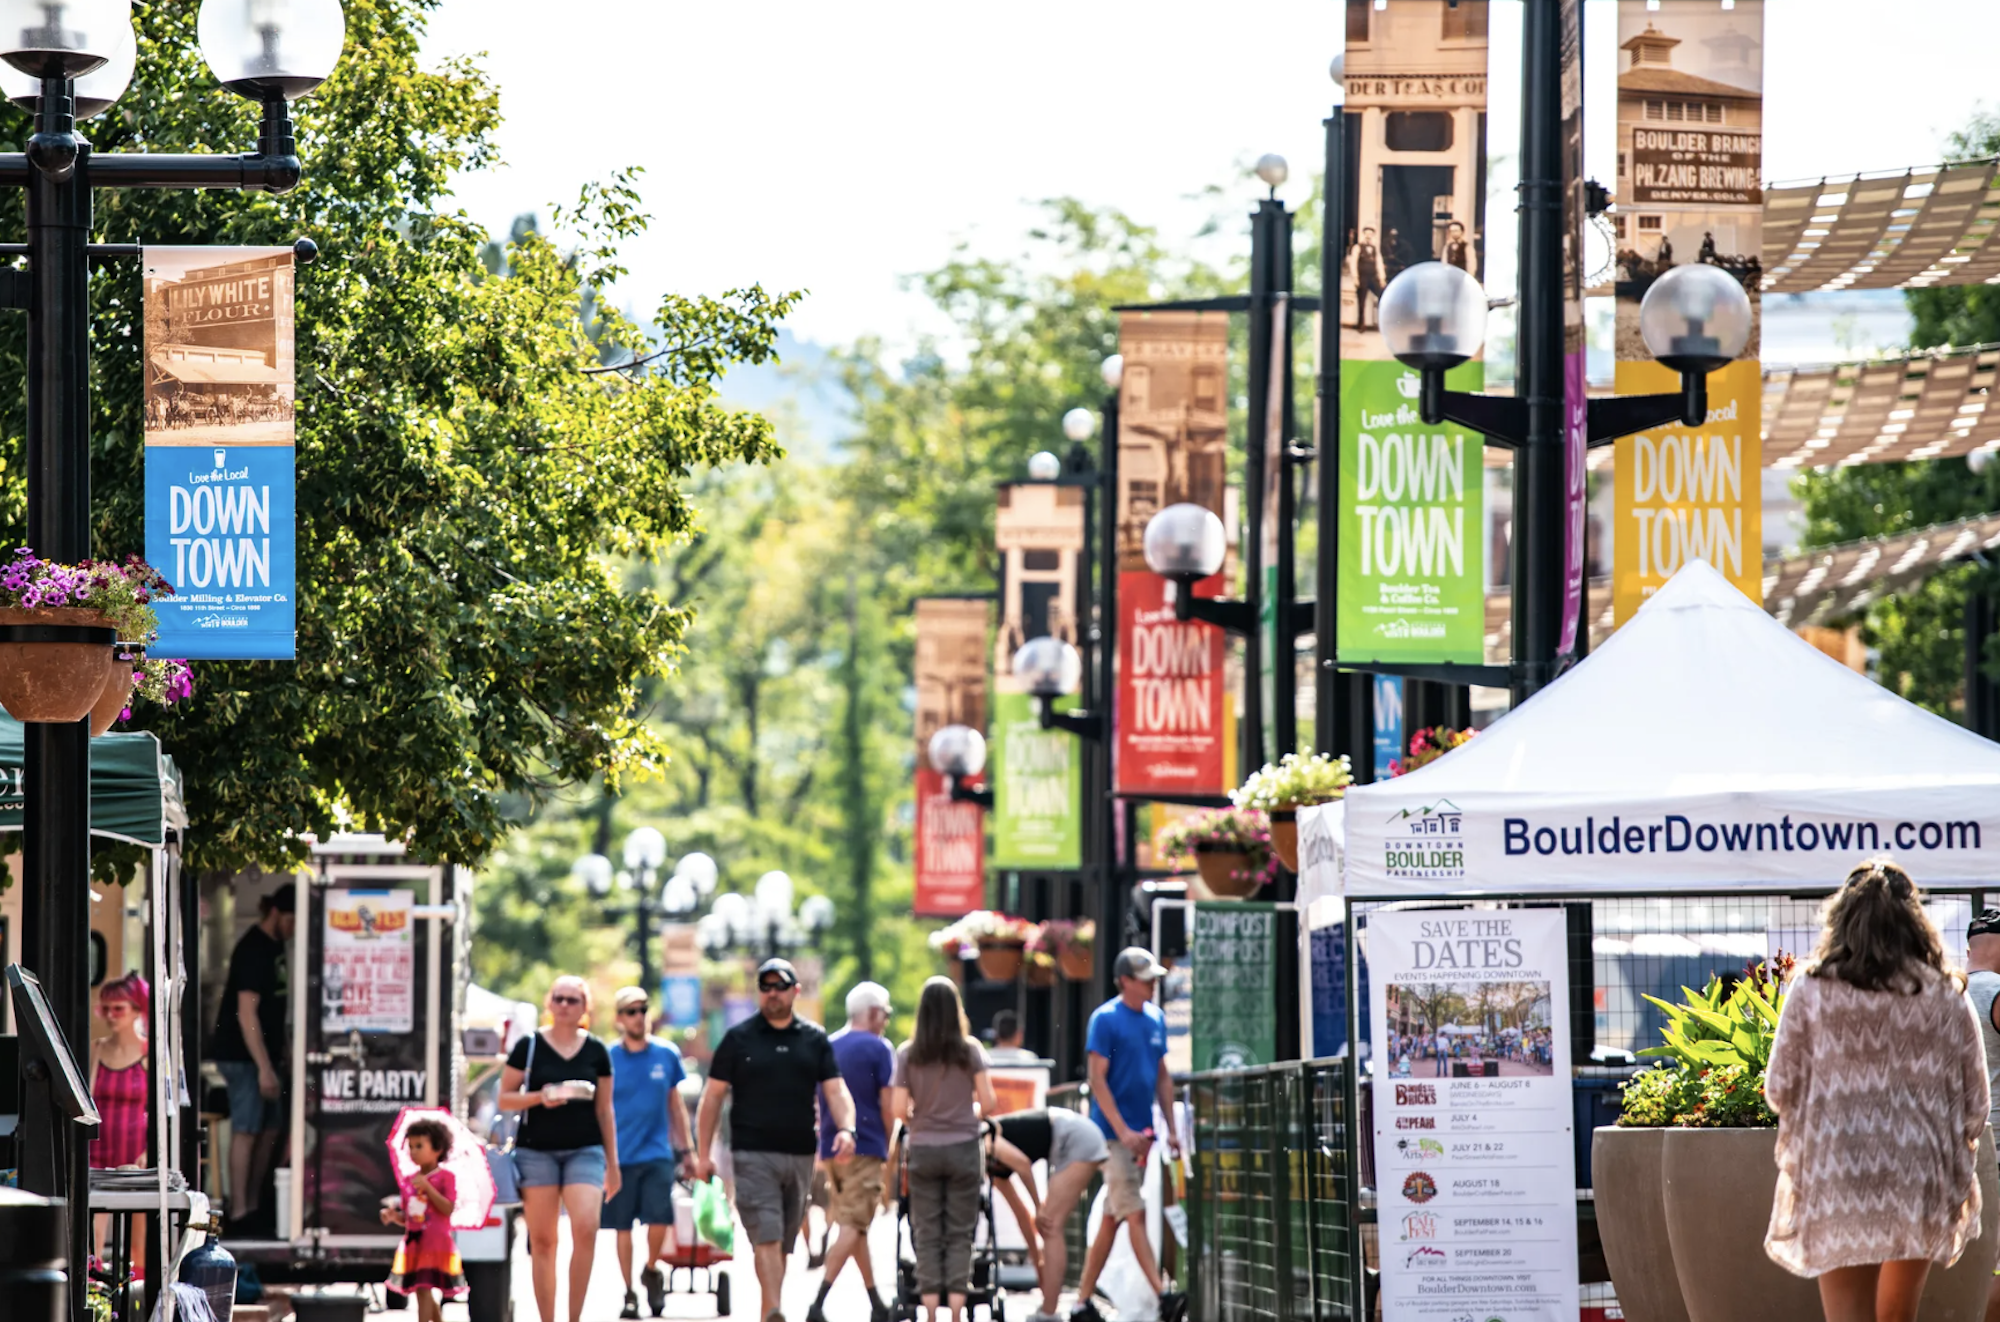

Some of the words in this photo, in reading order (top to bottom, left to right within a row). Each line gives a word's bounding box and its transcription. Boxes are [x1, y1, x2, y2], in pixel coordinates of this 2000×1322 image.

[1635, 131, 1707, 151] BOULDER
[1672, 152, 1695, 160] OF
[1699, 153, 1731, 162] THE
[173, 286, 206, 309] LILY
[208, 277, 270, 305] WHITE
[1361, 409, 1395, 430] Love
[1396, 403, 1417, 425] the
[1704, 399, 1738, 423] ocal
[189, 472, 210, 484] Love
[210, 469, 223, 482] the
[224, 466, 249, 481] Local
[1357, 433, 1464, 502] DOWN
[1634, 435, 1741, 503] DOWN
[170, 485, 269, 535] DOWN
[1355, 505, 1464, 577] TOWN
[1632, 508, 1742, 578] TOWN
[170, 538, 269, 588] TOWN
[190, 593, 223, 604] Milling
[225, 594, 233, 602] &
[235, 594, 272, 602] Elevator
[274, 593, 288, 602] Co.
[1132, 625, 1211, 677] DOWN
[1131, 678, 1210, 731] TOWN
[1385, 841, 1464, 850] DOWNTOWN
[1503, 815, 1982, 855] BoulderDowntown.com
[1385, 851, 1464, 868] BOULDER
[1195, 912, 1274, 937] COMPOST
[1420, 921, 1469, 938] SAVE
[1472, 919, 1512, 937] THE
[1195, 938, 1272, 963] COMPOST
[1411, 939, 1523, 969] DATES
[1430, 971, 1481, 980] HAPPENING
[1483, 970, 1541, 979] DOWNTOWN
[322, 1069, 356, 1098] WE
[359, 1069, 427, 1098] PARTY
[1450, 1081, 1472, 1089] JUNE
[1489, 1080, 1522, 1088] AUGUST
[1451, 1114, 1470, 1122] JULY
[1472, 1114, 1478, 1122] 4
[1452, 1143, 1471, 1152] JULY
[1473, 1143, 1482, 1151] 21
[1485, 1143, 1491, 1151] &
[1493, 1143, 1504, 1151] 22
[1453, 1180, 1487, 1188] AUGUST
[1490, 1179, 1500, 1187] 18
[1515, 1218, 1524, 1226] 15
[1526, 1218, 1532, 1226] &
[1534, 1218, 1544, 1226] 16
[1455, 1249, 1500, 1257] SEPTEMBER
[1502, 1249, 1512, 1257] 20
[1418, 1283, 1537, 1294] BoulderDowntown.com
